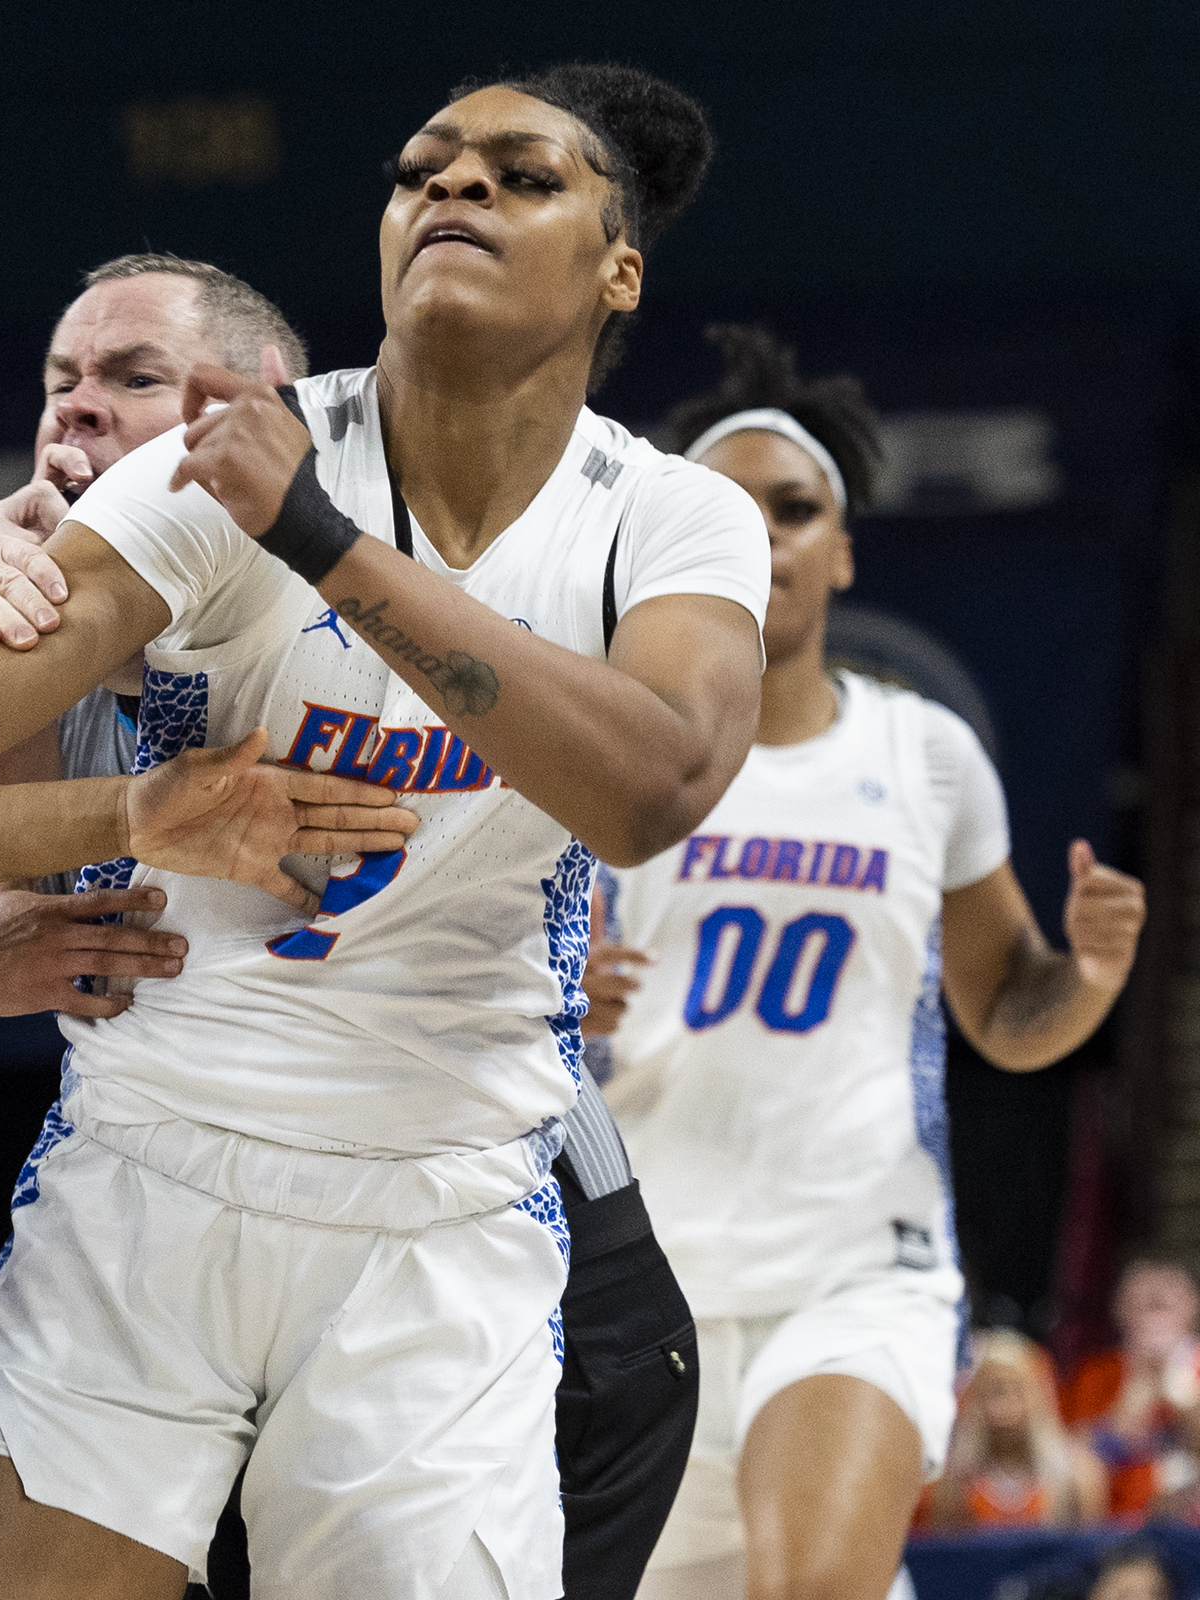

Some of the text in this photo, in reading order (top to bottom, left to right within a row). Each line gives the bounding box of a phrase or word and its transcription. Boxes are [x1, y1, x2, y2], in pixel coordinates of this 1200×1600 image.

[277, 700, 514, 794] FLRID
[675, 834, 890, 894] FLORIDA
[683, 903, 858, 1033] 00
